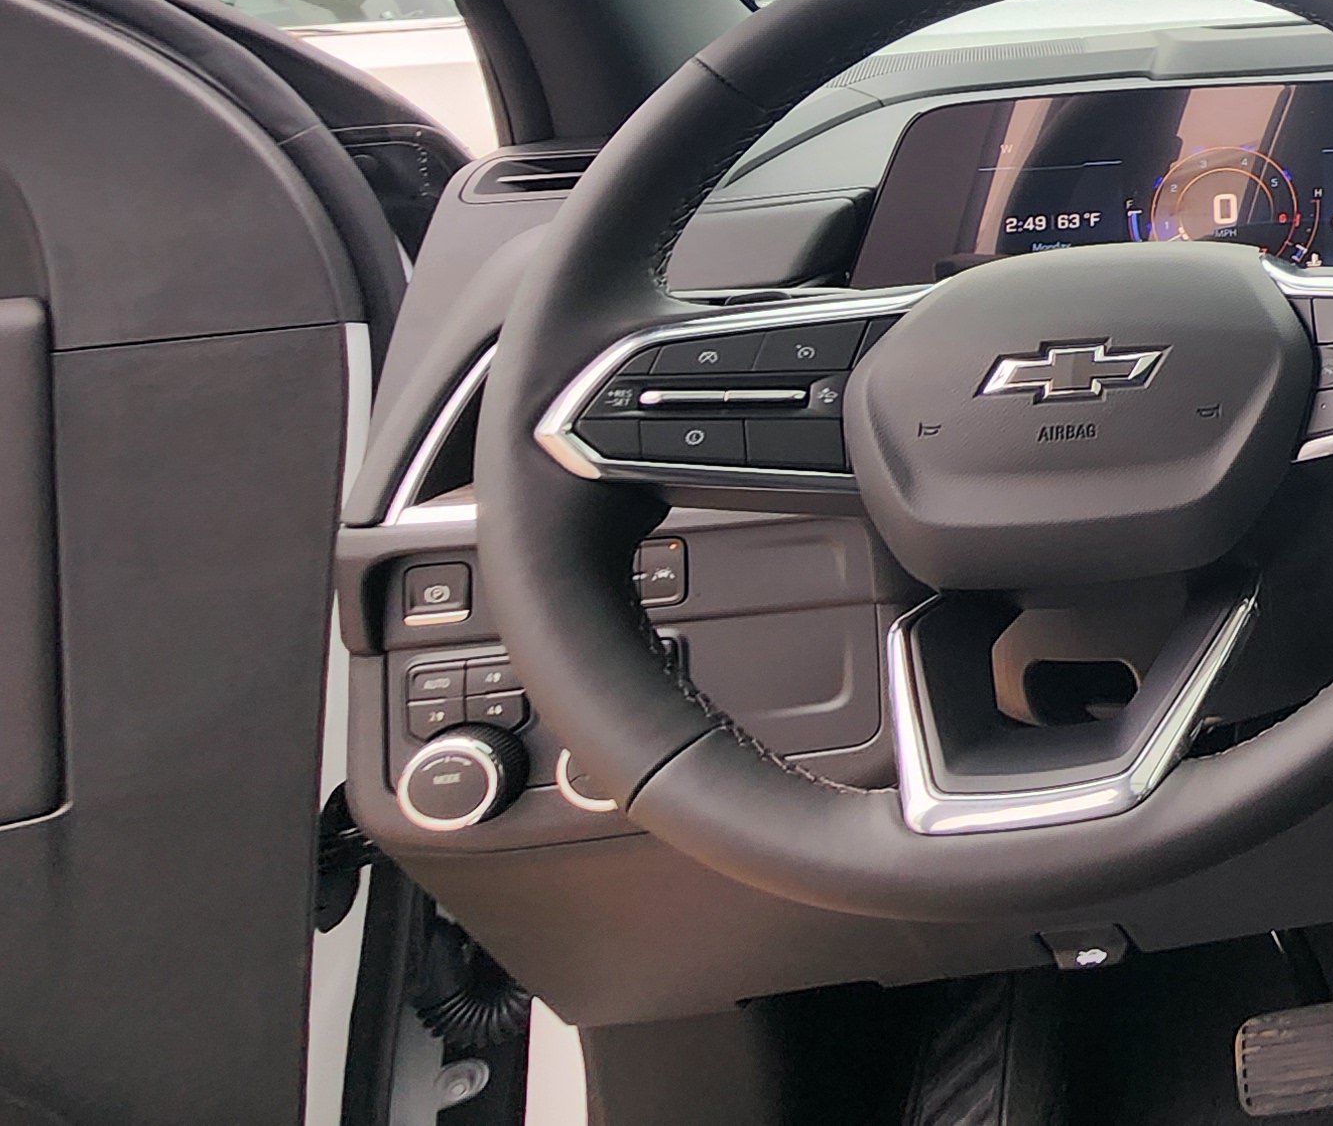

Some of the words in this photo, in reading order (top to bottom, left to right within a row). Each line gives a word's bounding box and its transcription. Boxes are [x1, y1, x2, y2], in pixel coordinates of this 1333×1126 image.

[1314, 189, 1322, 197] H
[1125, 199, 1134, 210] F
[1213, 193, 1237, 224] 0
[1005, 215, 1047, 233] 2:49
[1215, 228, 1237, 239] MPH
[1037, 423, 1096, 442] AIRBAG
